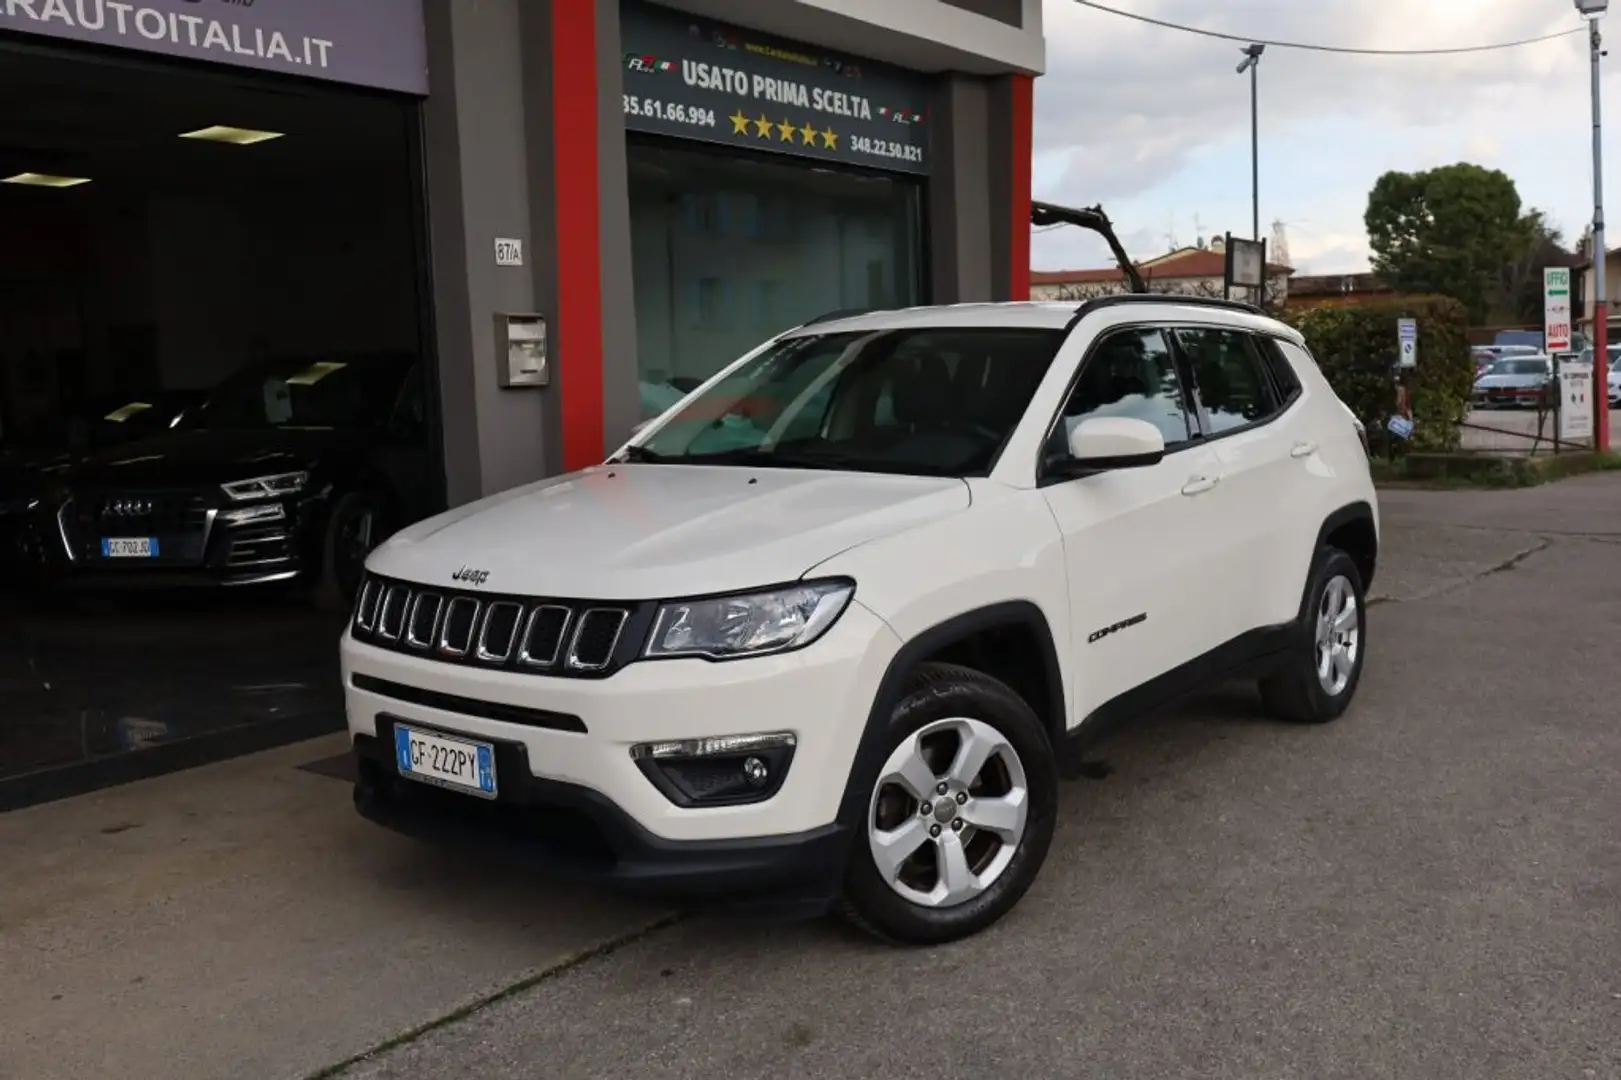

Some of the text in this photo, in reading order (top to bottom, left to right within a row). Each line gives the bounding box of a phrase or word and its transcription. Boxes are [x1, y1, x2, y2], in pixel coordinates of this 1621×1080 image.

[0, 0, 333, 67] RAUTOITALIA.IT
[682, 59, 749, 96] USATO
[752, 75, 809, 108] PRIMA
[812, 88, 871, 120] SCELTA
[497, 243, 520, 260] 87/A
[1548, 323, 1568, 338] AUTO
[452, 564, 490, 586] Jeep
